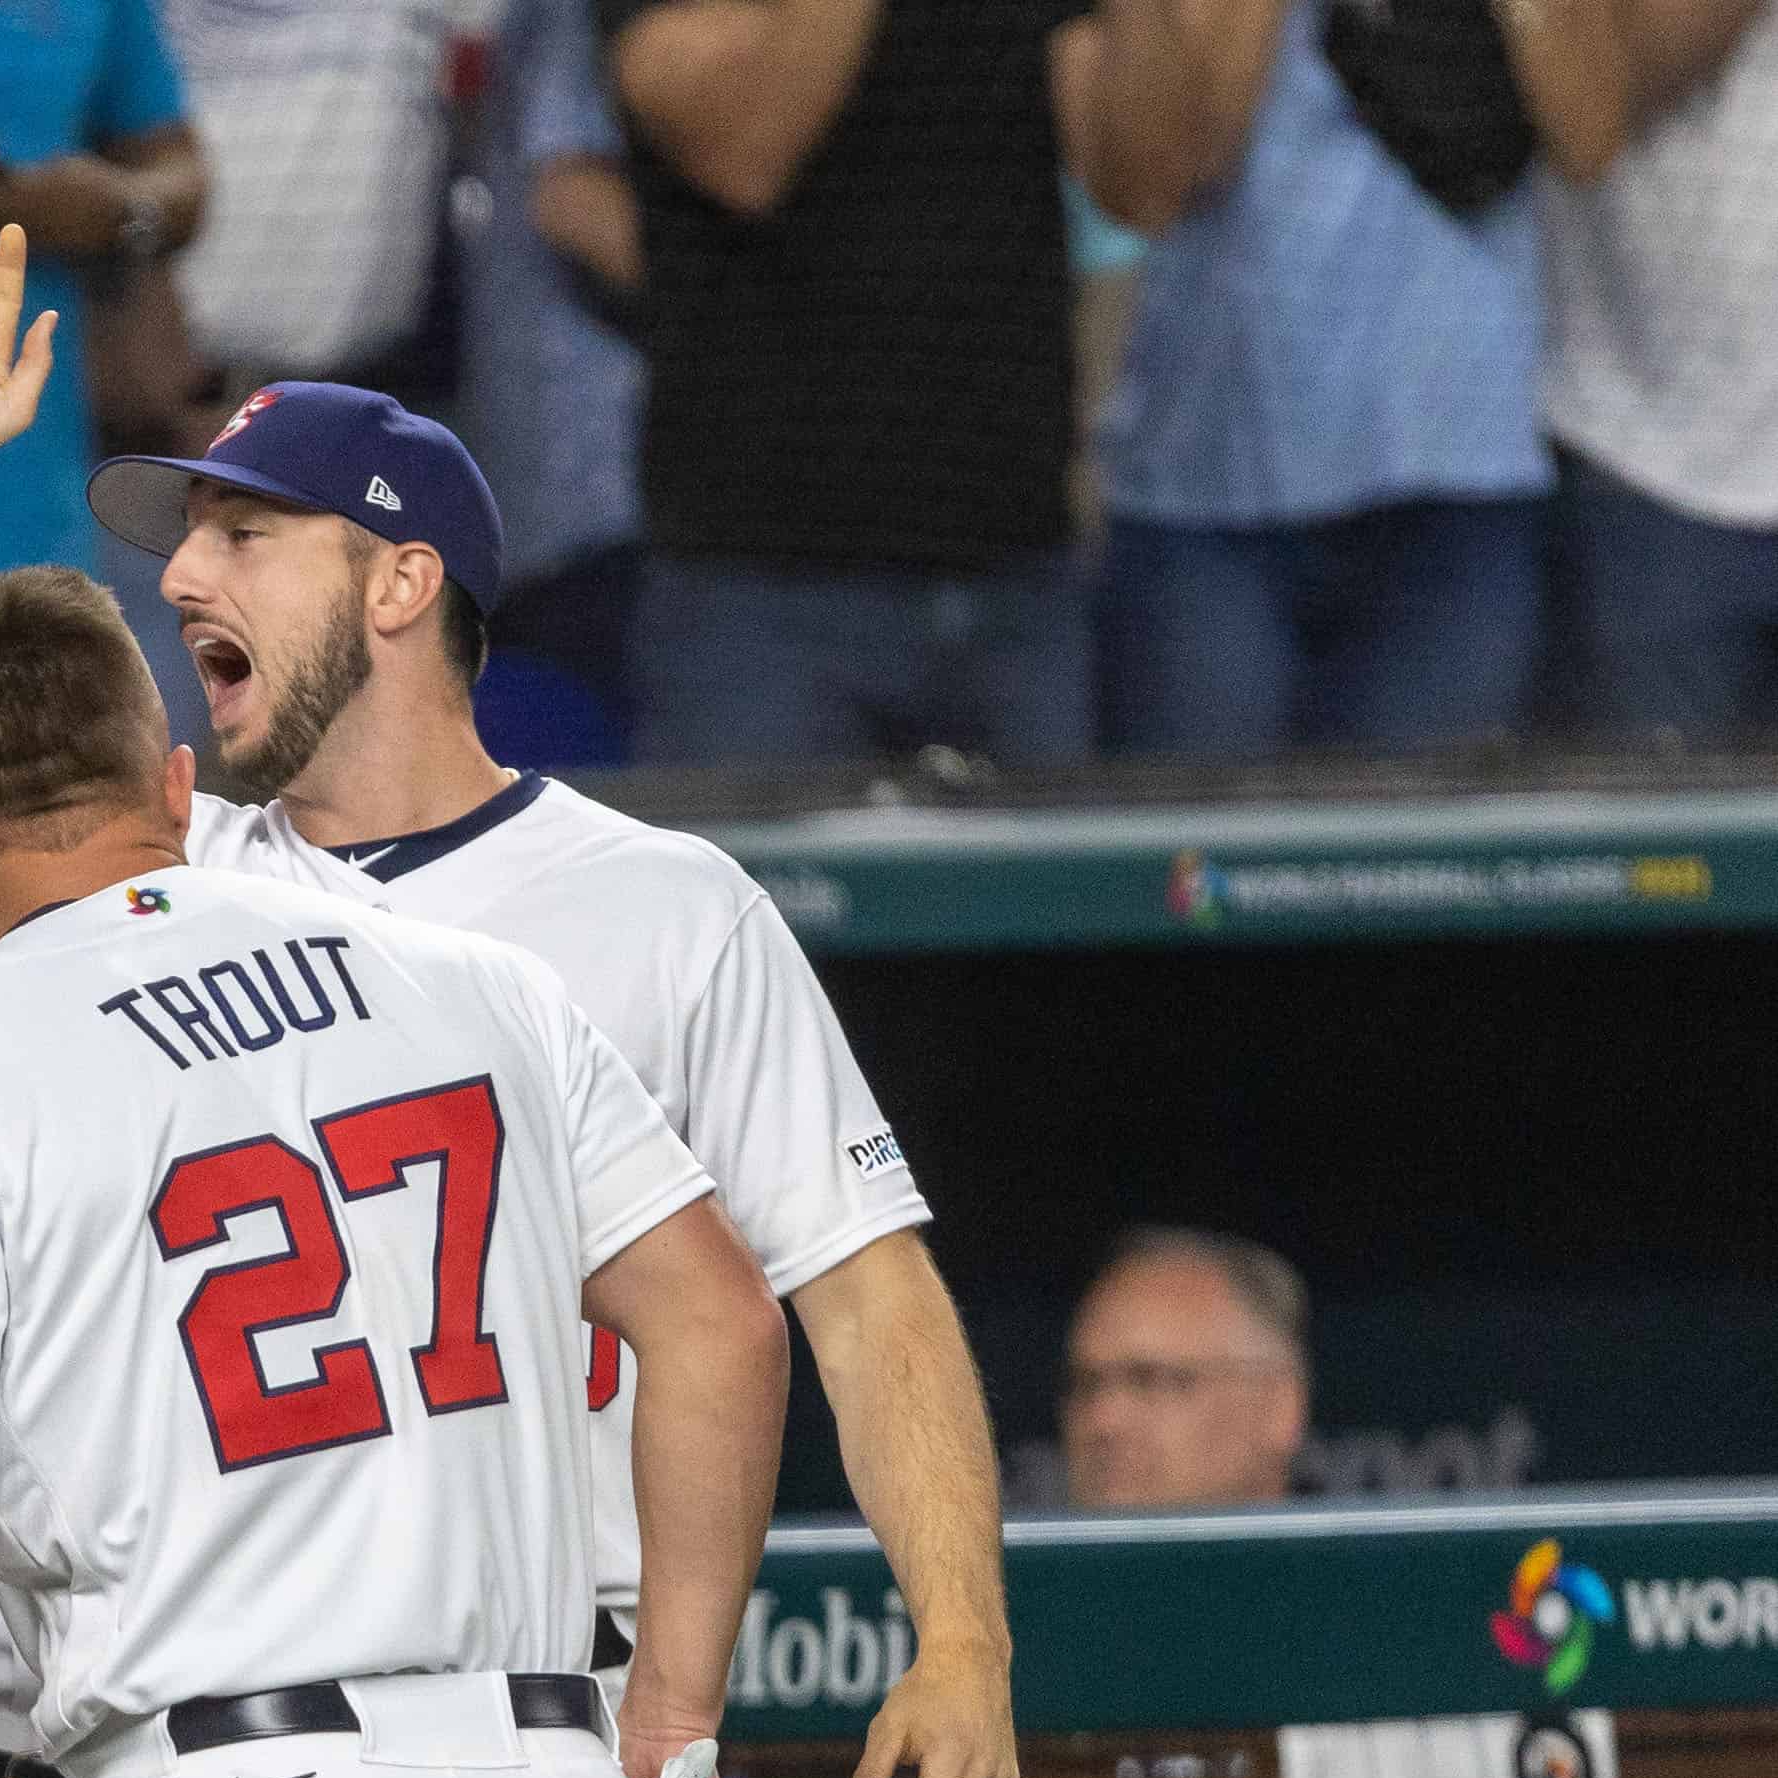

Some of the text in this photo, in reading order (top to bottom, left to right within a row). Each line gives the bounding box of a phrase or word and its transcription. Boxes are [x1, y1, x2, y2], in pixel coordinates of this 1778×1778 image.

[97, 935, 372, 1071] TROUT
[147, 1073, 510, 1476] 27
[726, 1586, 911, 1707] obi
